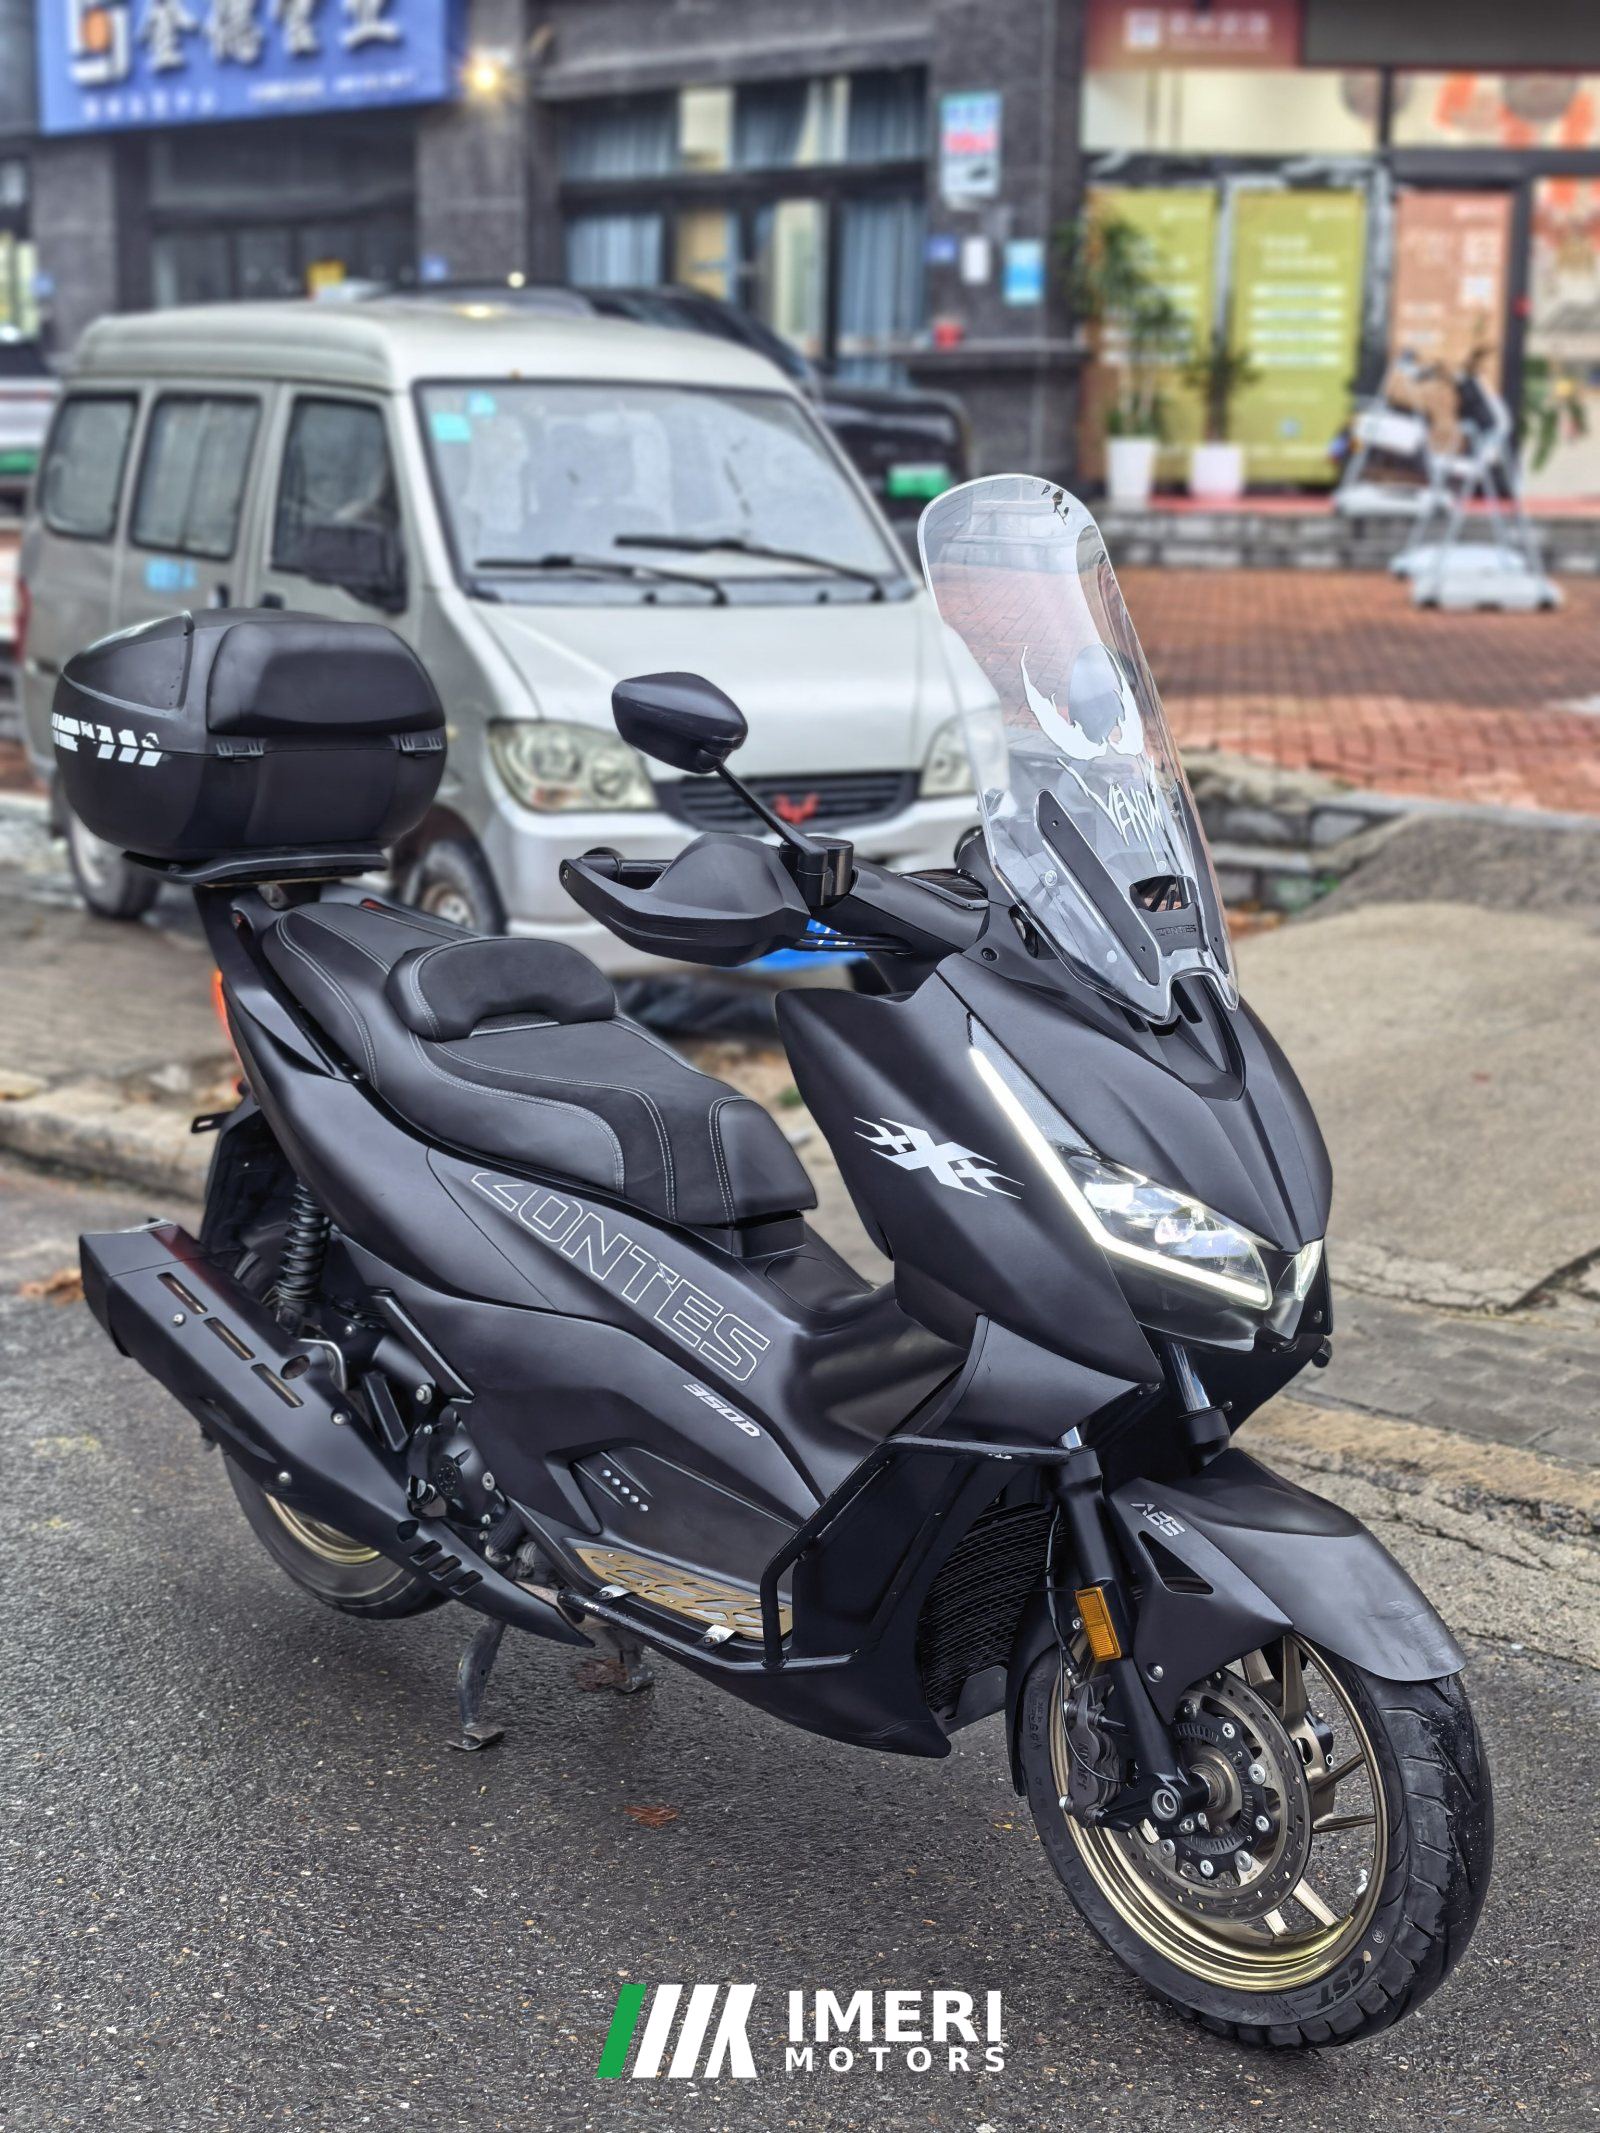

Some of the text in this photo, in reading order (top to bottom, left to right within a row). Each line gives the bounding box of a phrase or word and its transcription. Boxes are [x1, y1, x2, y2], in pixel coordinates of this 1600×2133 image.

[470, 1172, 771, 1381] ZONTES
[682, 1383, 761, 1438] 350D
[1130, 1503, 1186, 1537] ABS
[1315, 1957, 1367, 2011] CST
